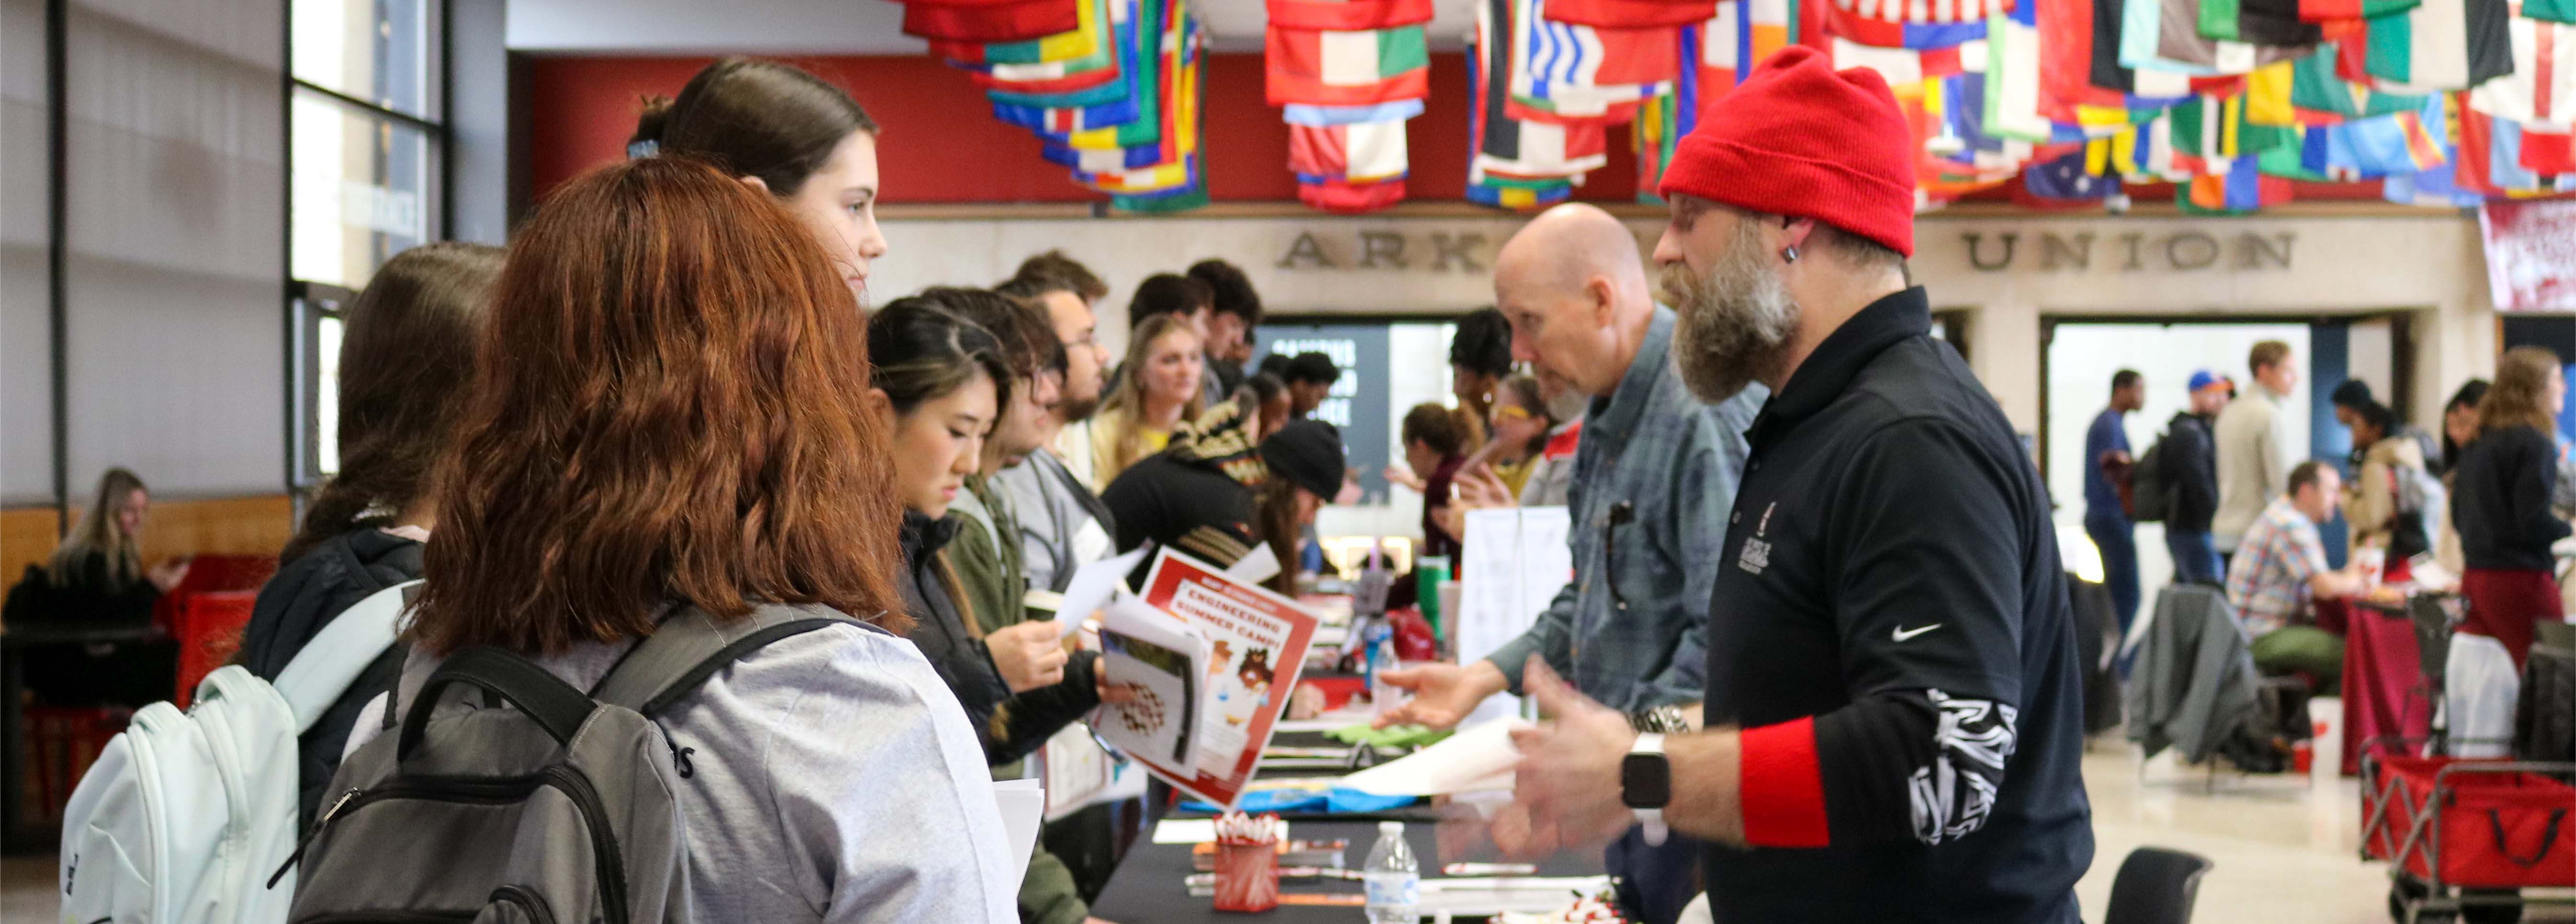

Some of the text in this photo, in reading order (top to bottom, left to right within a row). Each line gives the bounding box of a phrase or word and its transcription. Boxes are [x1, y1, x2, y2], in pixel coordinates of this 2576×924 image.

[1276, 230, 2297, 274] ARK UNION
[1176, 601, 1234, 631] SUMMER
[1188, 589, 1280, 633] ENGINEERING
